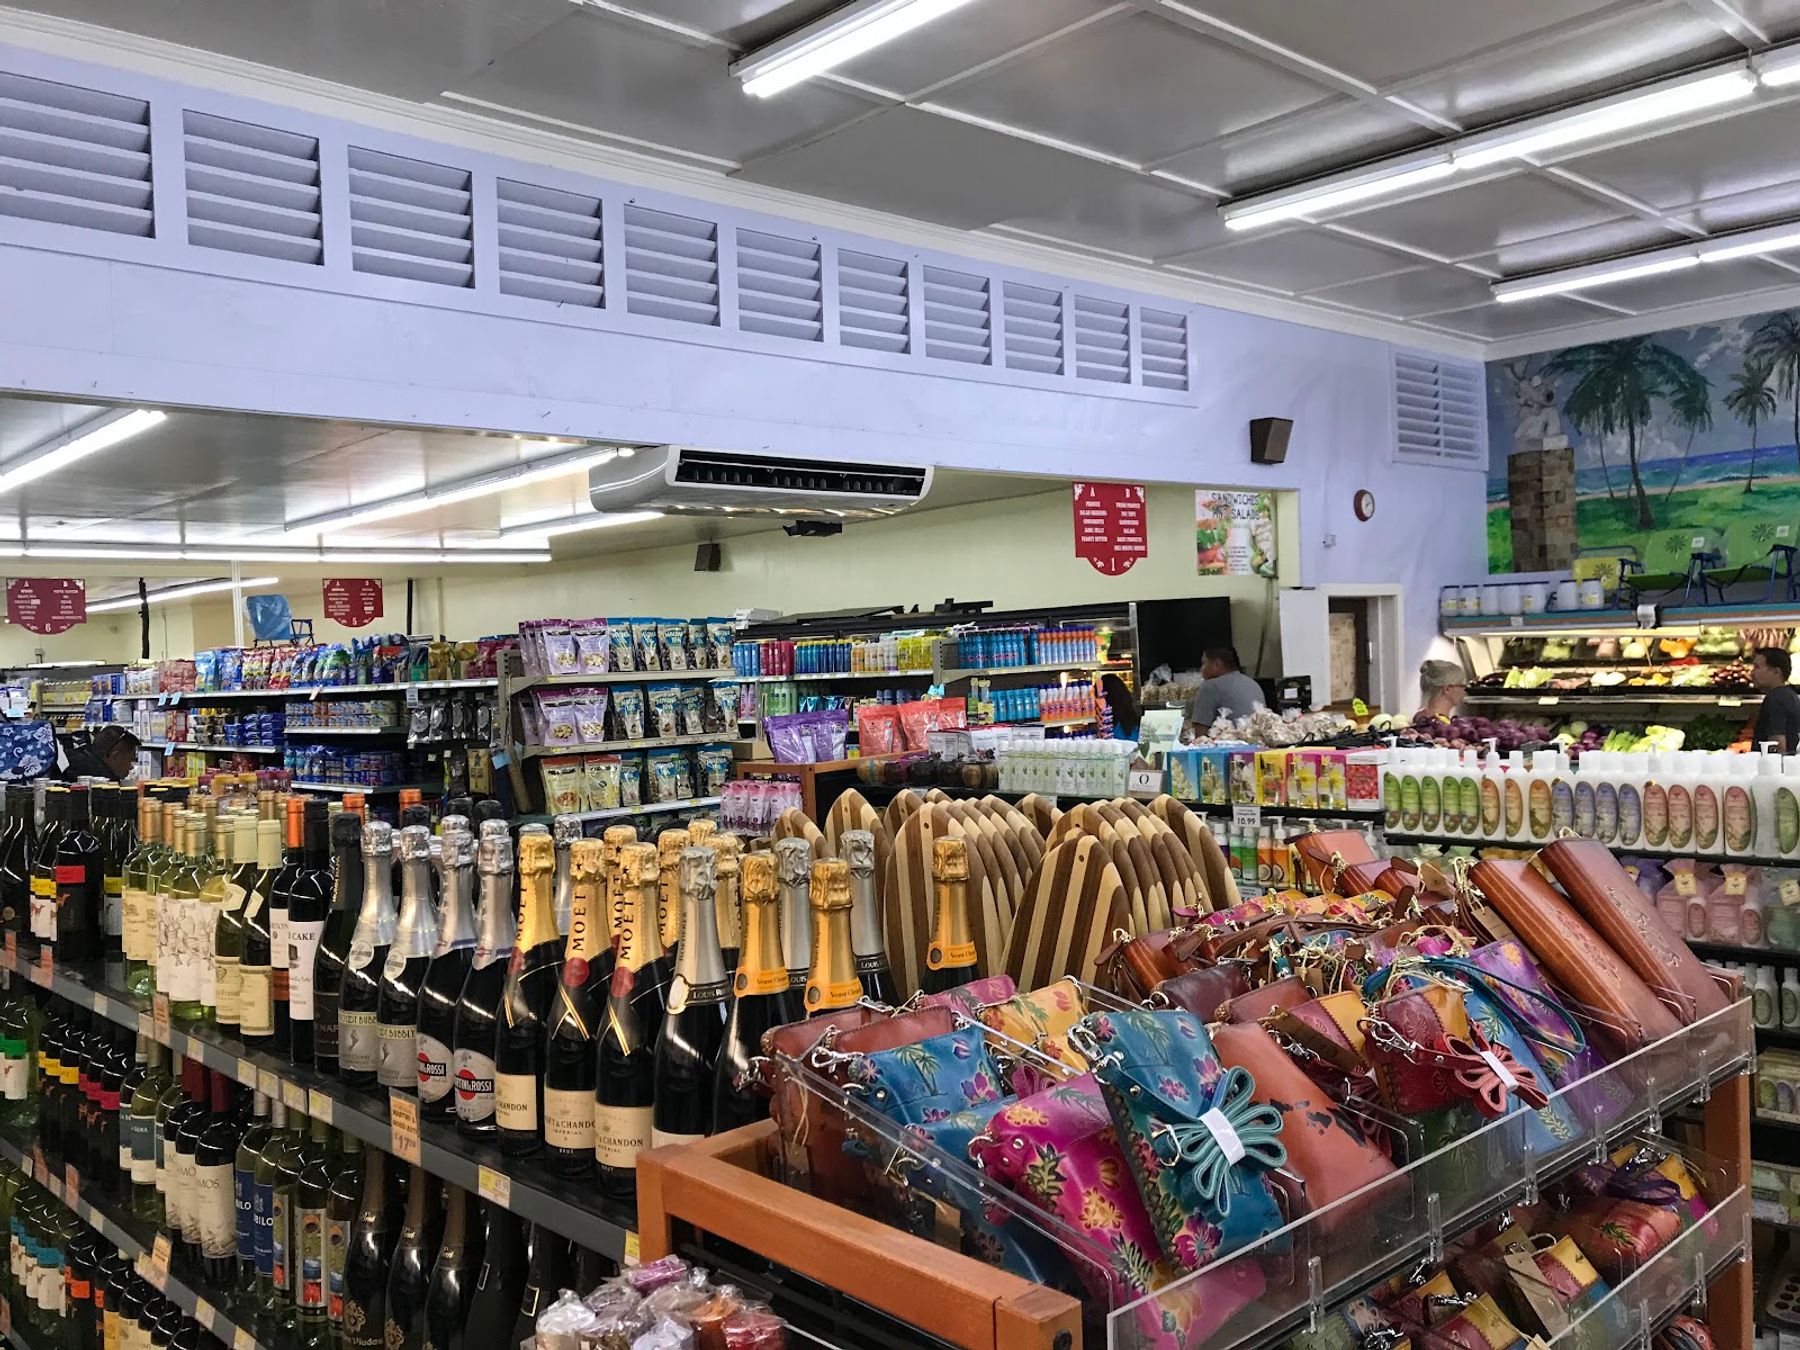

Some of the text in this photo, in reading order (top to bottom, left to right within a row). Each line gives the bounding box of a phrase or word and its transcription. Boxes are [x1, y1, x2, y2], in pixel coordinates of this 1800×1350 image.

[1089, 486, 1096, 498] A
[1124, 488, 1131, 499] B
[1211, 492, 1261, 506] SANDWICHES
[1231, 508, 1261, 521] SALADS
[352, 617, 358, 626] 5
[45, 623, 51, 632] 6
[1237, 817, 1256, 825] 10.99
[292, 932, 316, 941] CAKE
[426, 1063, 445, 1075] ROSSI
[471, 1080, 492, 1092] ROSSI
[603, 1136, 644, 1147] CHANDON
